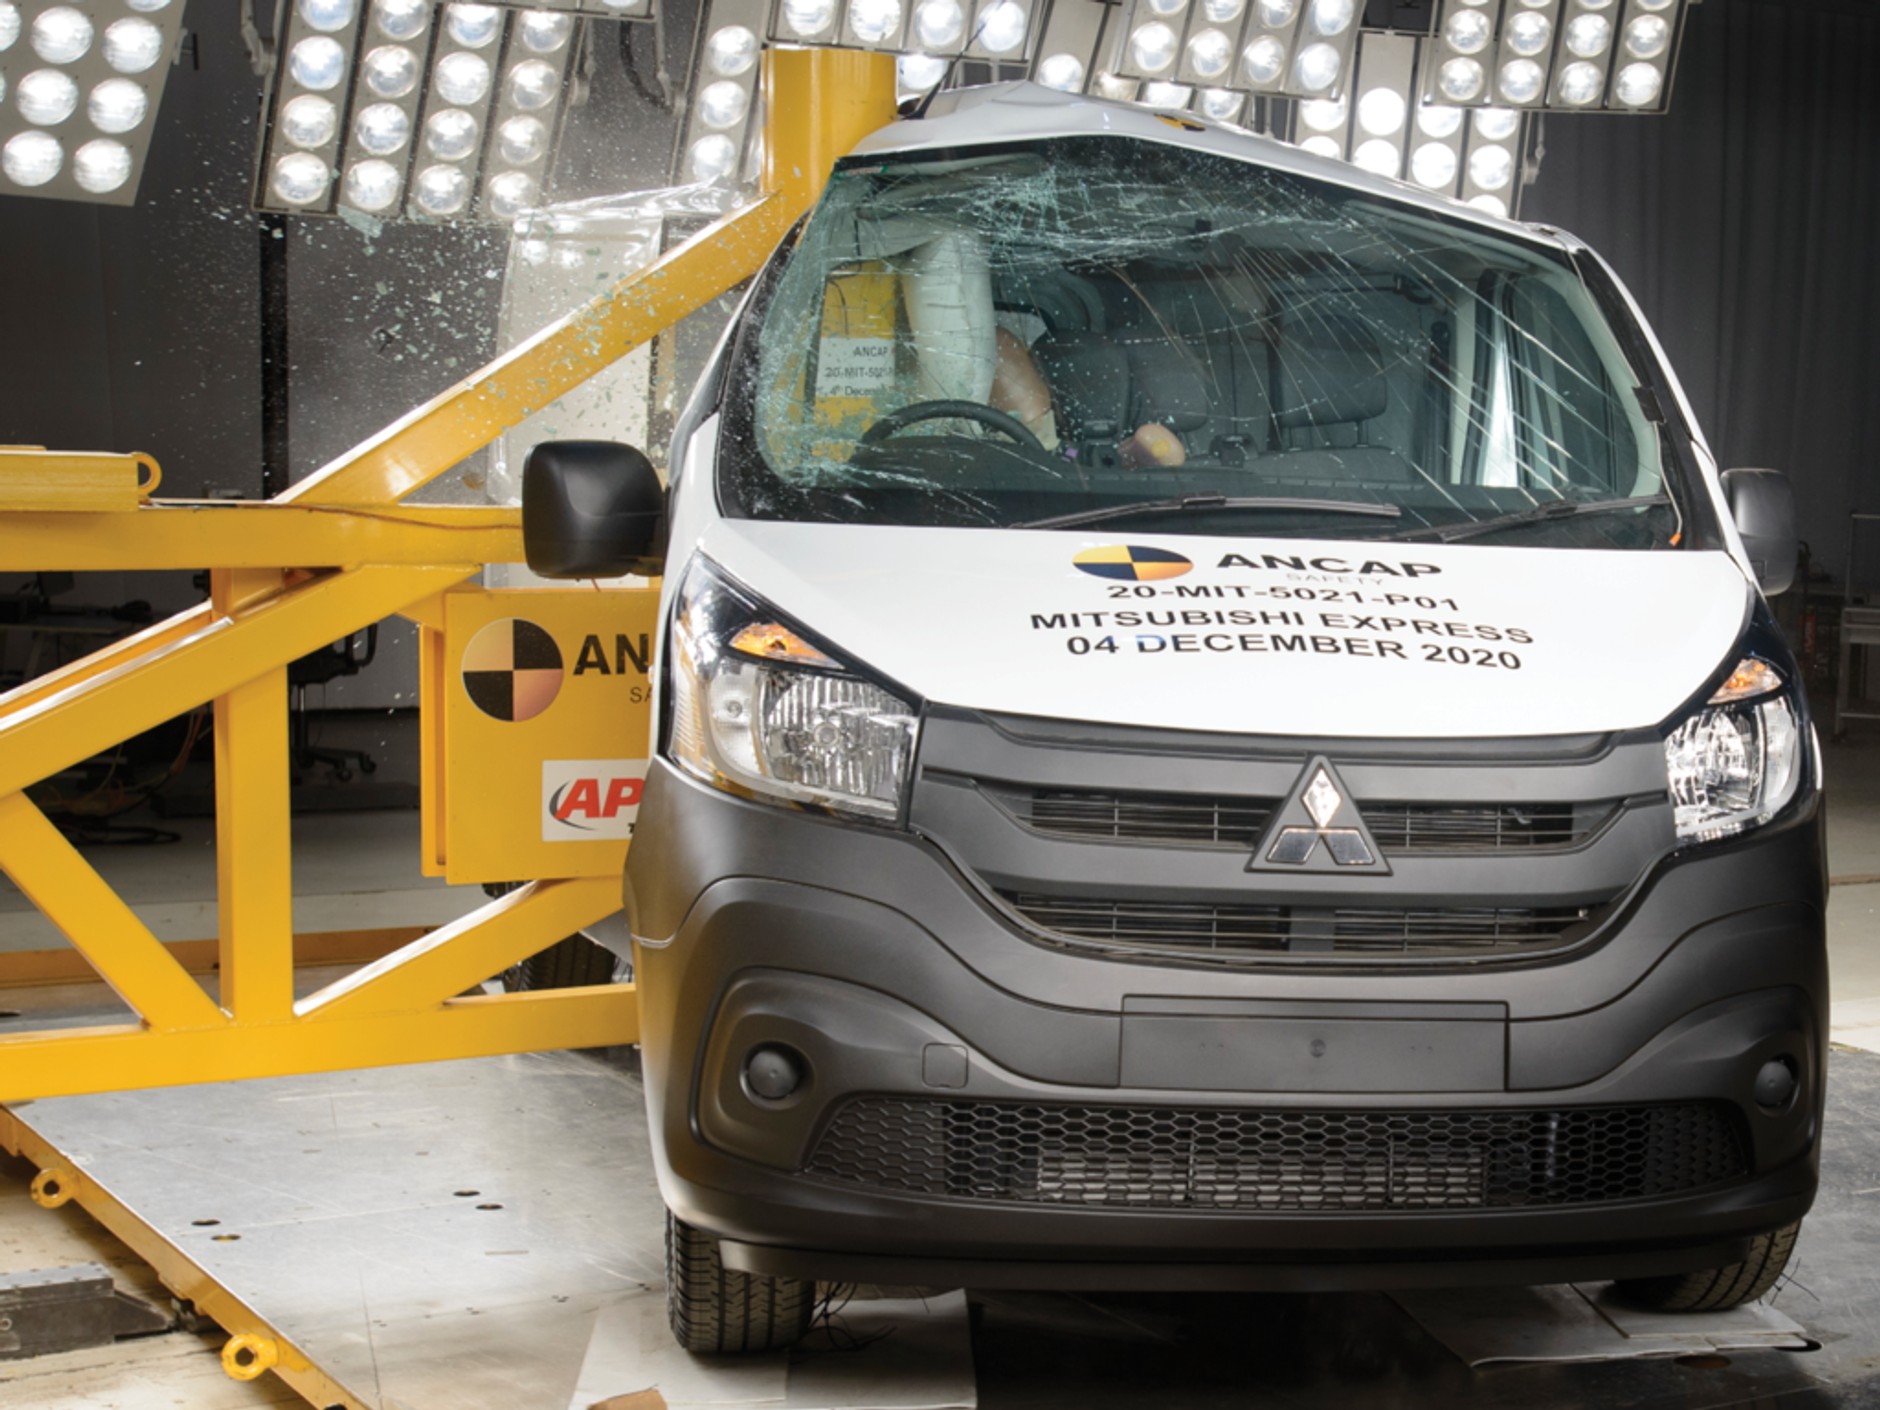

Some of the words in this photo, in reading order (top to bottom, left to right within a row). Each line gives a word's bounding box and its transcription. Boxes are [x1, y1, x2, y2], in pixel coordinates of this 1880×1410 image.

[853, 345, 888, 357] ANCAP
[1216, 553, 1442, 577] ANCAP
[1285, 572, 1384, 586] SAFETY
[1107, 584, 1459, 612] 20-MIT-5021-P01
[1030, 610, 1305, 630] MITSUBISHI
[1318, 612, 1535, 644] EXPRESS
[1066, 635, 1120, 655] 04
[1135, 633, 1409, 660] DECEMBER
[1420, 643, 1522, 670] 2020
